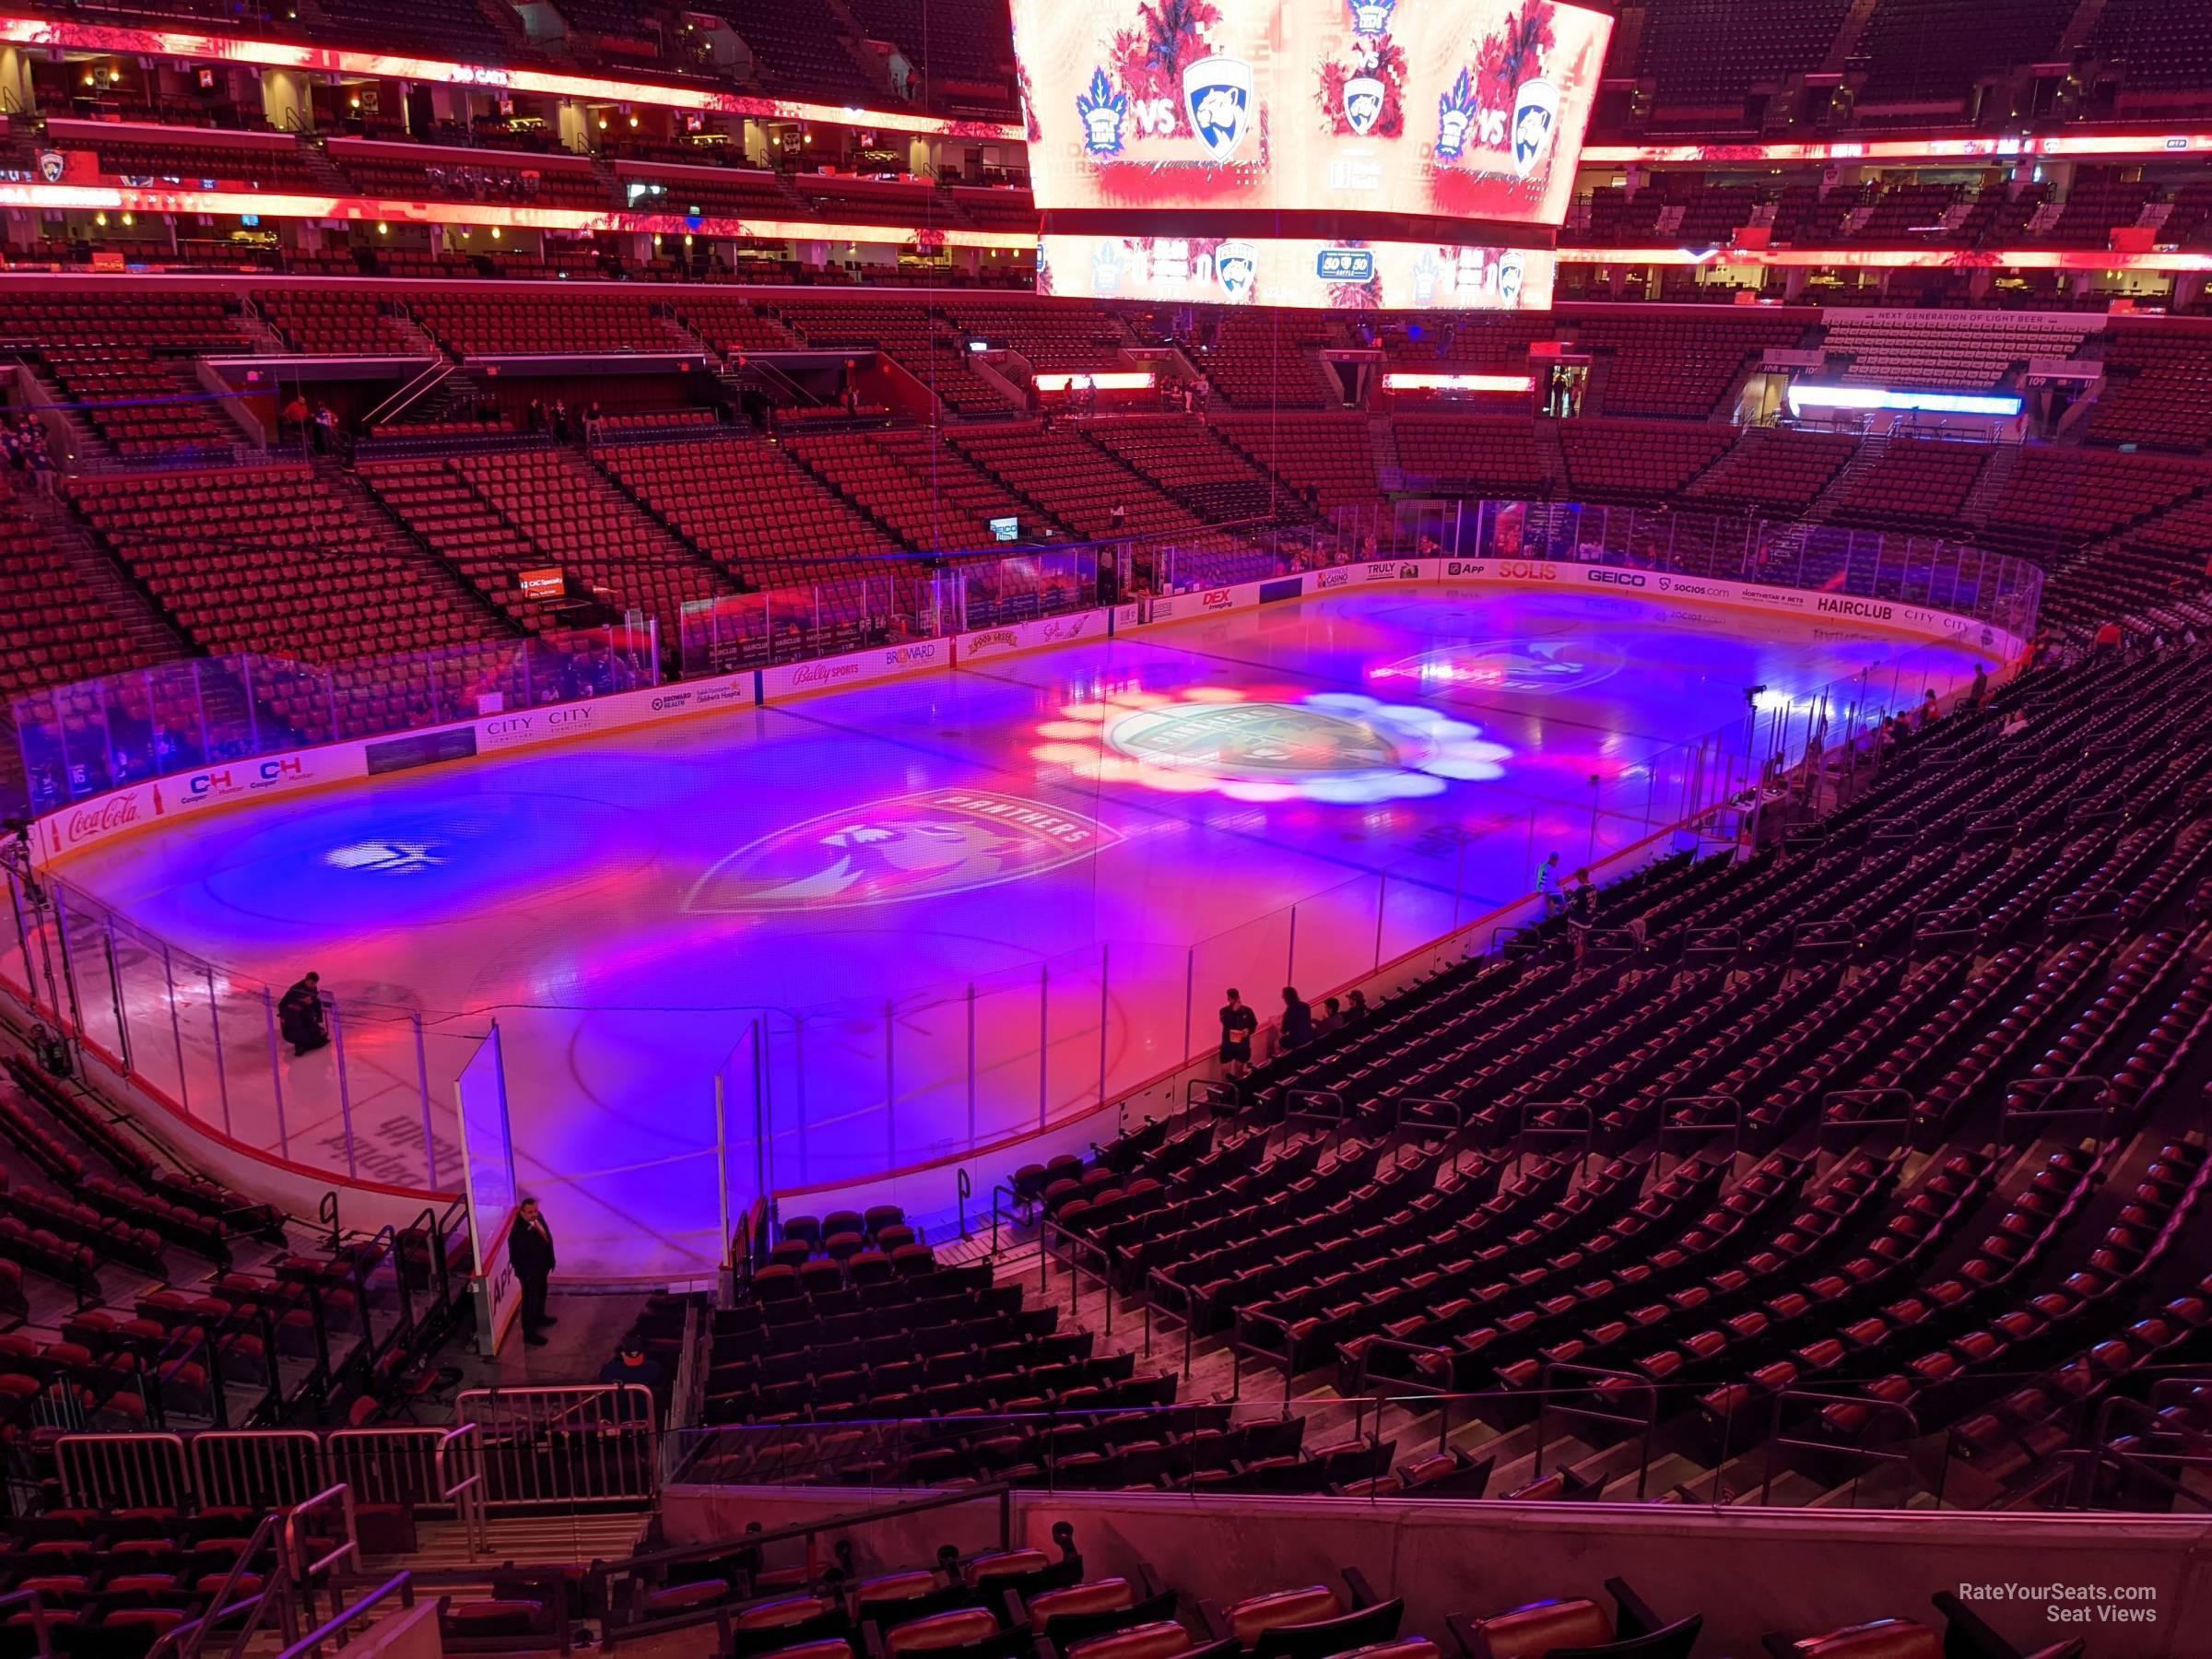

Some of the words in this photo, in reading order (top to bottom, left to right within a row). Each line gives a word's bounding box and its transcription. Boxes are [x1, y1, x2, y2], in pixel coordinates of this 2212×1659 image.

[1357, 51, 1380, 69] VS
[1136, 98, 1176, 134] VS
[1477, 108, 1507, 145] VS
[1906, 312, 1967, 321] GENERATION
[1986, 314, 2015, 323] LIGHT
[2018, 315, 2044, 324] BEER
[2029, 377, 2047, 385] 109
[1367, 563, 1395, 573] TRULY
[1499, 561, 1557, 580] SOLIS
[1327, 574, 1347, 583] CASINO
[1588, 570, 1645, 586] GEICO
[1203, 589, 1230, 606] DEX
[1818, 597, 1892, 620] HAIRCLUB
[1904, 609, 1935, 623] CITY
[1944, 618, 1969, 632] CITY
[973, 633, 992, 646] GOOD
[993, 632, 1013, 642] GREEK
[793, 665, 830, 686] Bally
[831, 664, 859, 677] SPORTS
[664, 692, 691, 701] BROWARD
[548, 707, 592, 724] CITY
[487, 717, 533, 735] CITY
[72, 768, 86, 783] 16
[259, 757, 301, 780] CH
[190, 771, 232, 794] CH
[250, 779, 277, 790] Cooper
[181, 794, 207, 805] Cooper
[68, 793, 139, 842] Coca-Cola
[934, 795, 1091, 843] PANTHERS
